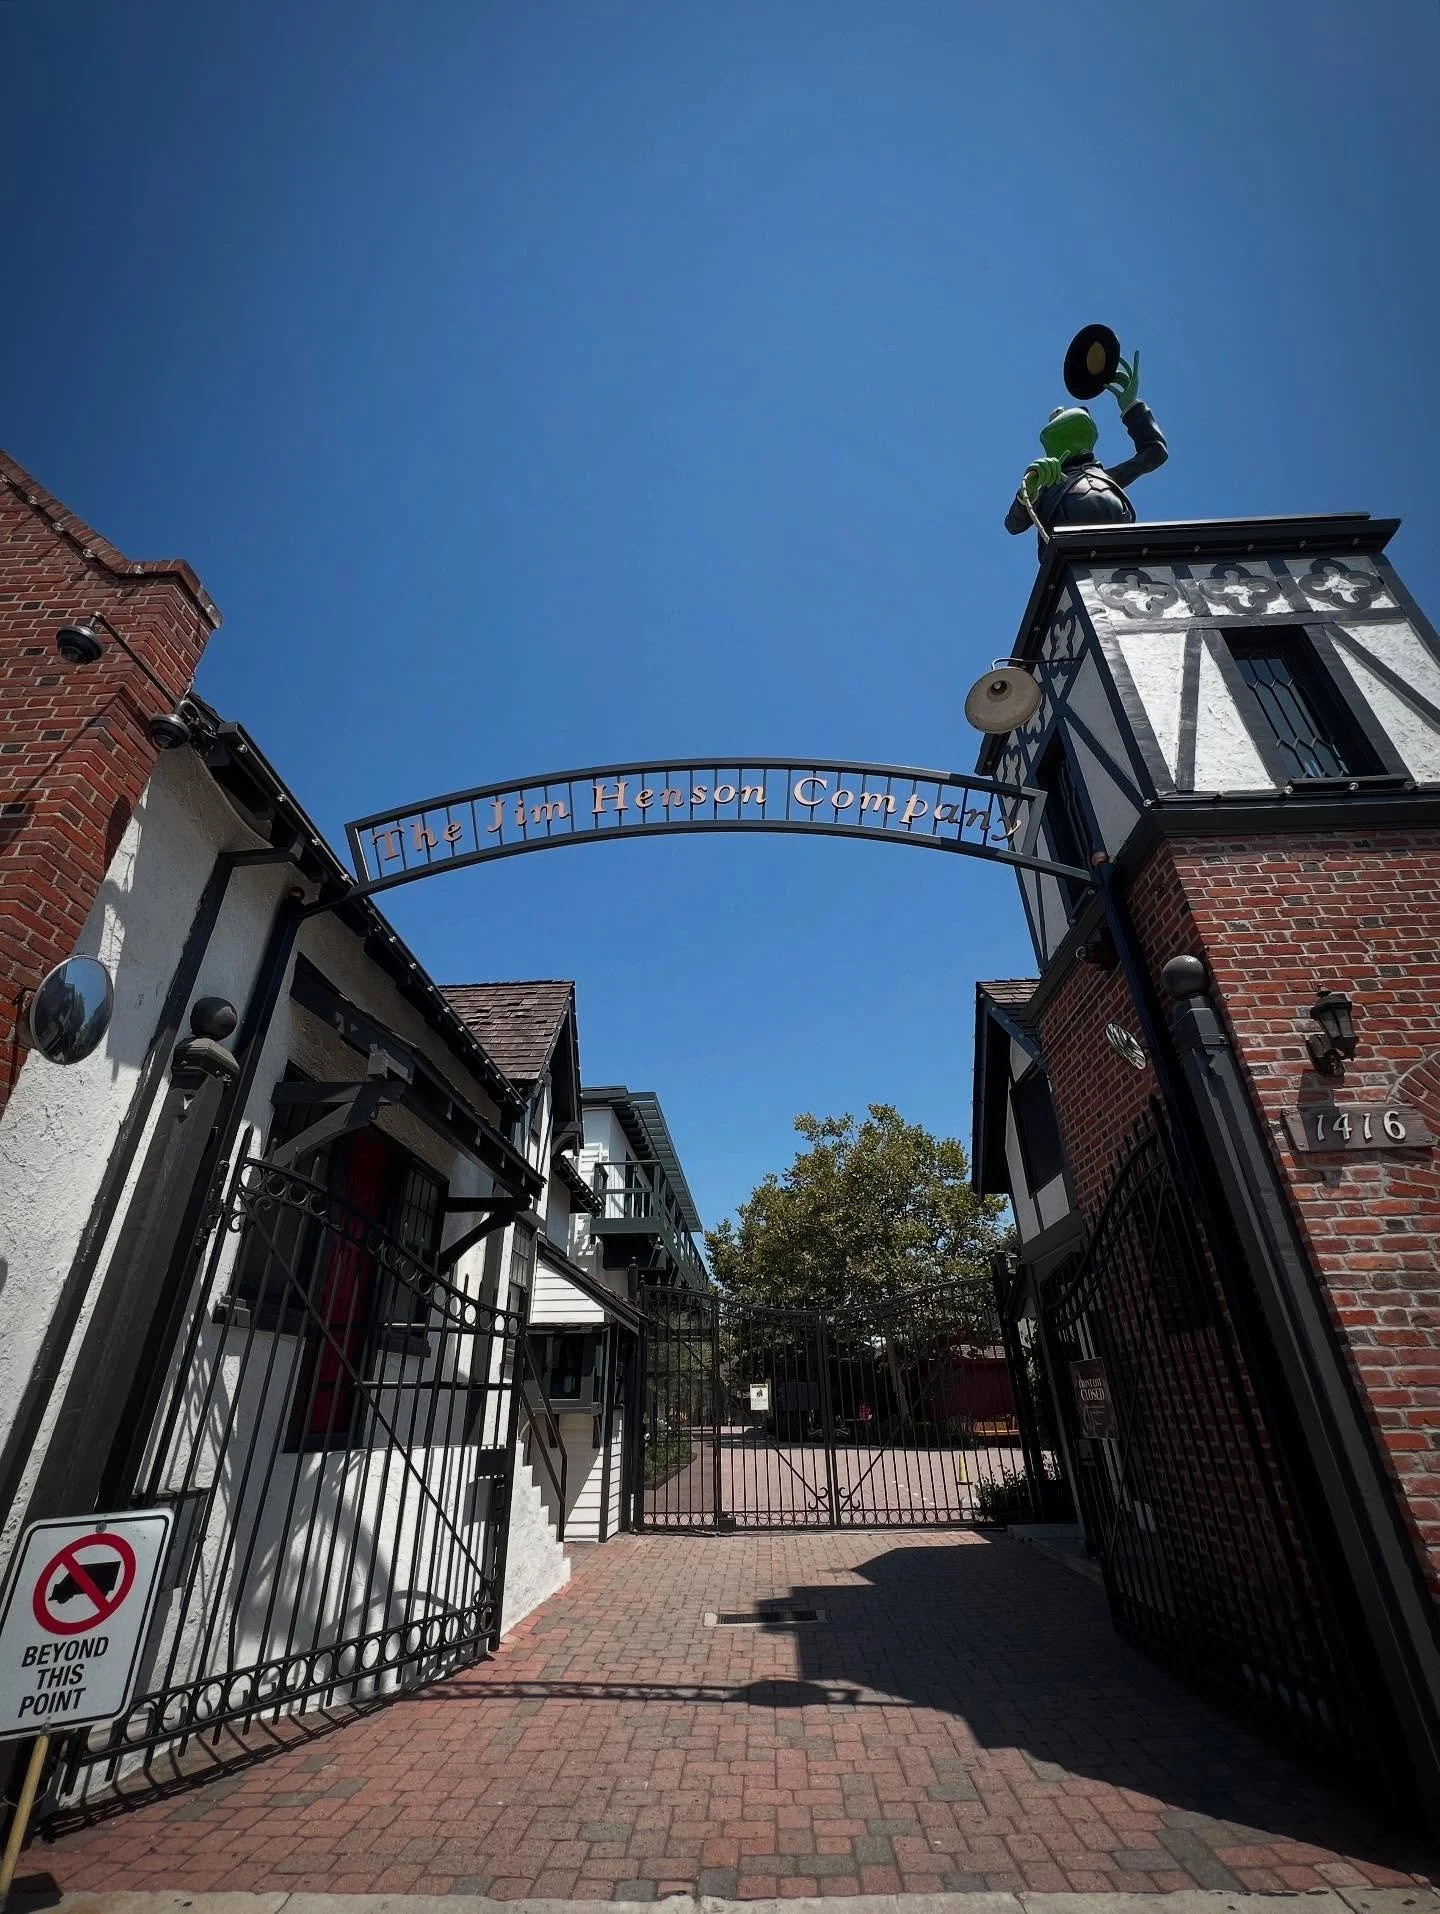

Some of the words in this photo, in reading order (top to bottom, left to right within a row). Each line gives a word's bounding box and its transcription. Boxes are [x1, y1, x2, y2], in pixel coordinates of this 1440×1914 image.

[372, 820, 464, 861] The
[487, 798, 571, 832] Jim
[592, 780, 767, 814] Henson
[793, 777, 1022, 841] Company
[1317, 1110, 1406, 1142] 1416
[1080, 1388, 1105, 1401] CLOSED
[21, 1636, 110, 1668] BEYOND
[37, 1663, 85, 1691] THIS
[17, 1687, 87, 1719] POINT
